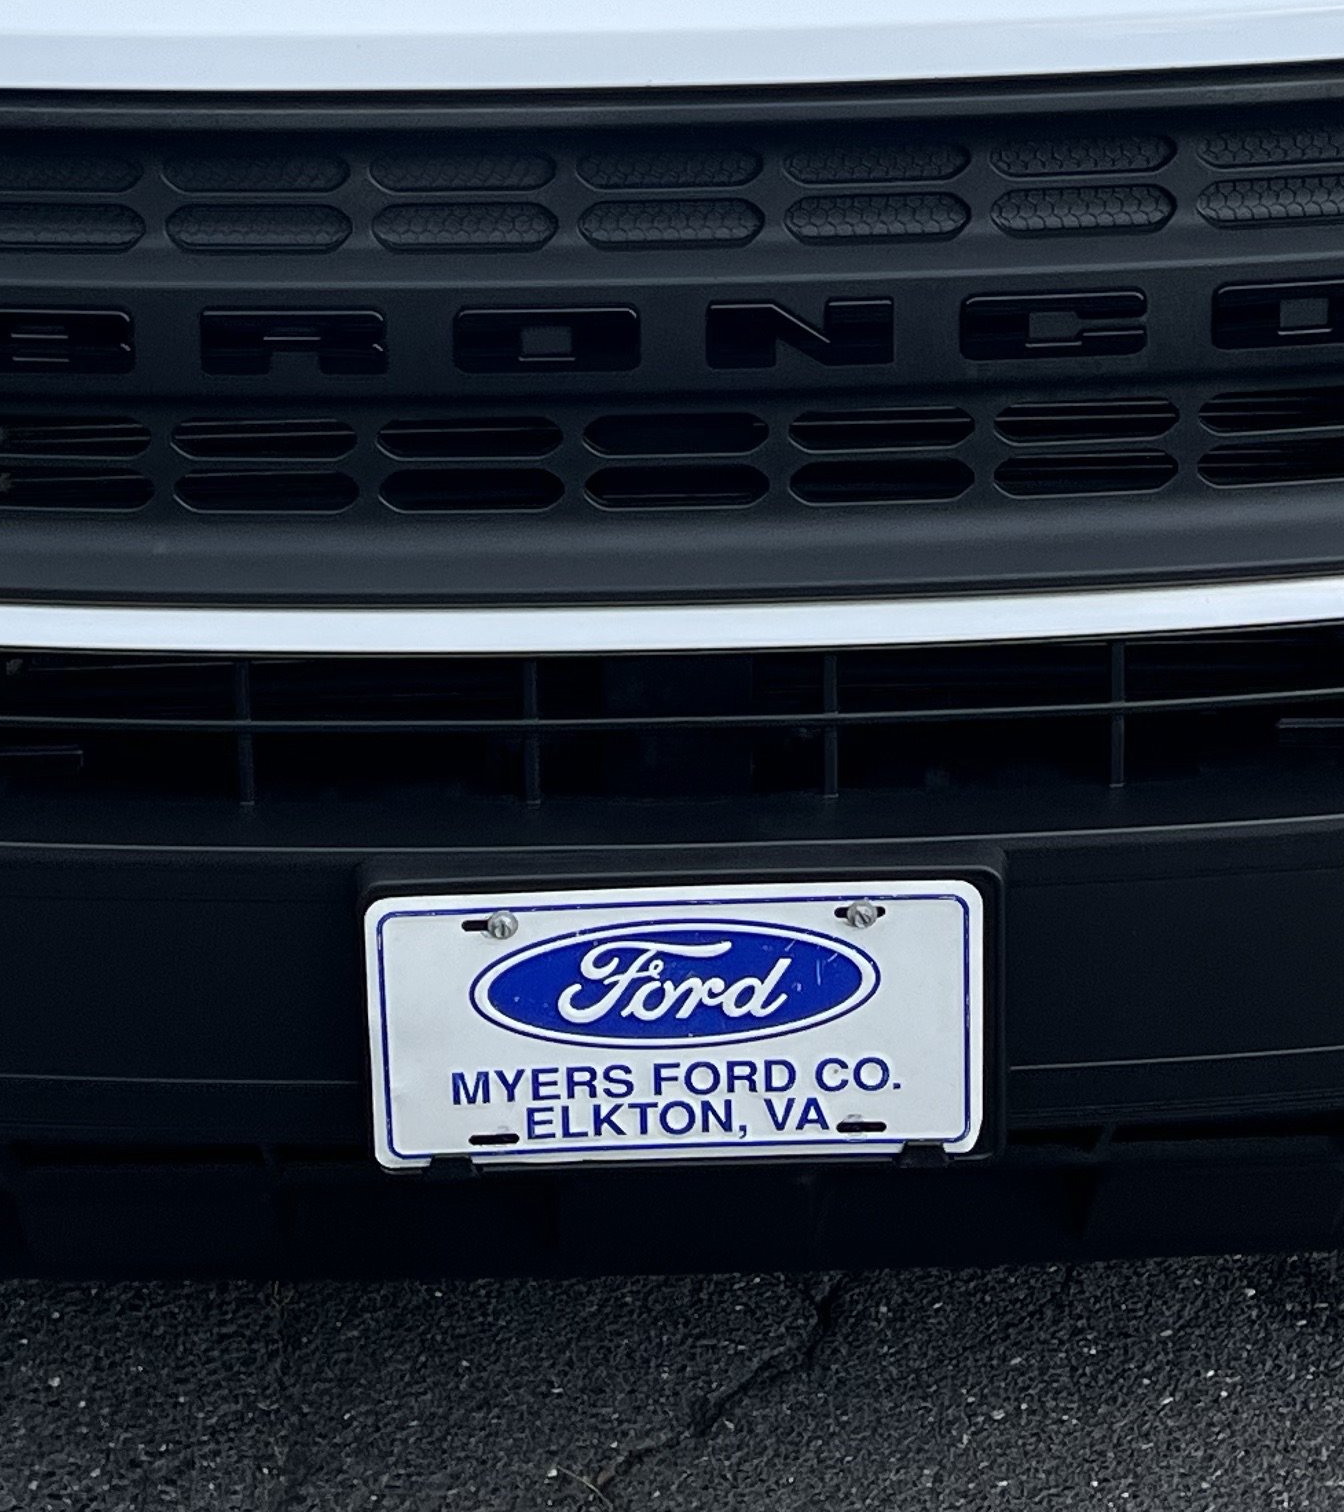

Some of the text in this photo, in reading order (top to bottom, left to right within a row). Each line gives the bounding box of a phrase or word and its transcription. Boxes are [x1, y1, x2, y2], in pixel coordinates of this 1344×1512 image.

[557, 939, 791, 1024] Ford
[451, 1056, 902, 1105] MYERS FORD CO.
[525, 1096, 830, 1141] ELKTON, VA
